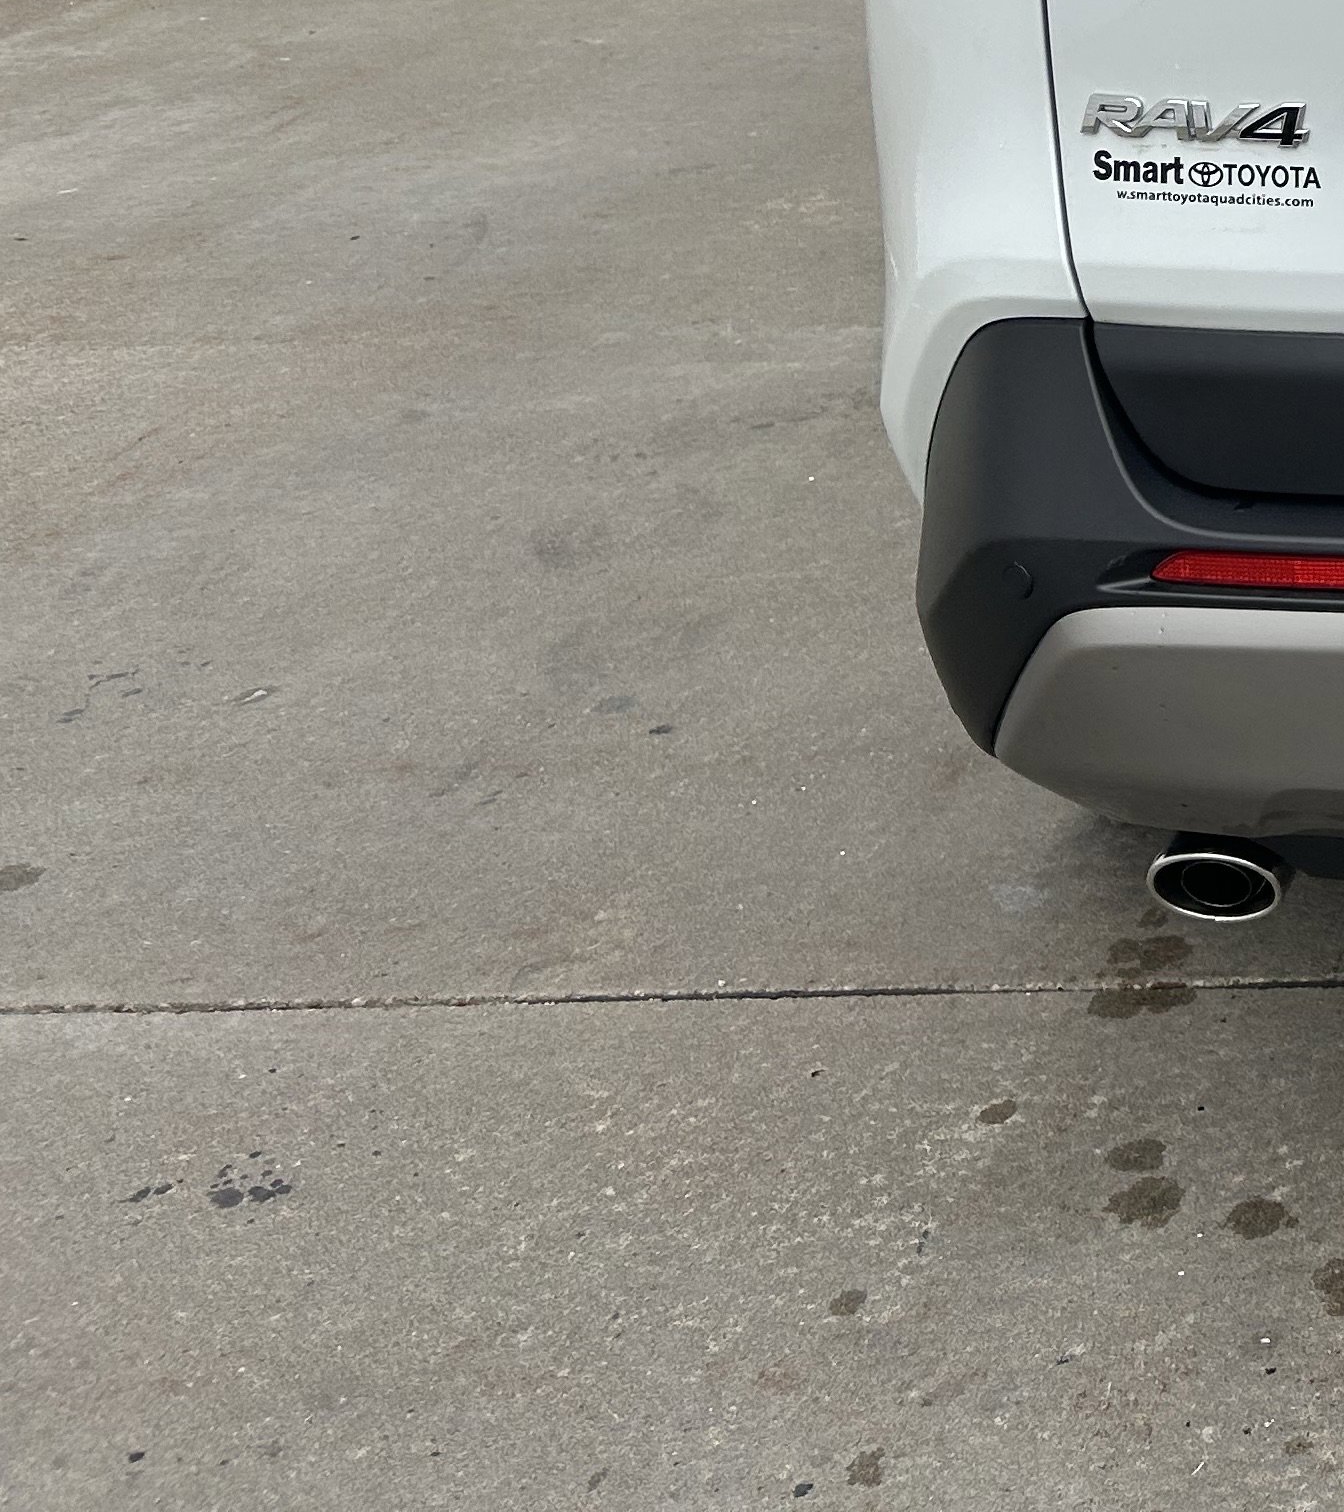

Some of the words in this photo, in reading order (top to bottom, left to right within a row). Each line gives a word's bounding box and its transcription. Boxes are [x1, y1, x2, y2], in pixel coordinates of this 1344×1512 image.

[1080, 92, 1311, 149] RAV4
[1092, 149, 1184, 185] Smart
[1222, 163, 1322, 189] TOYOTA
